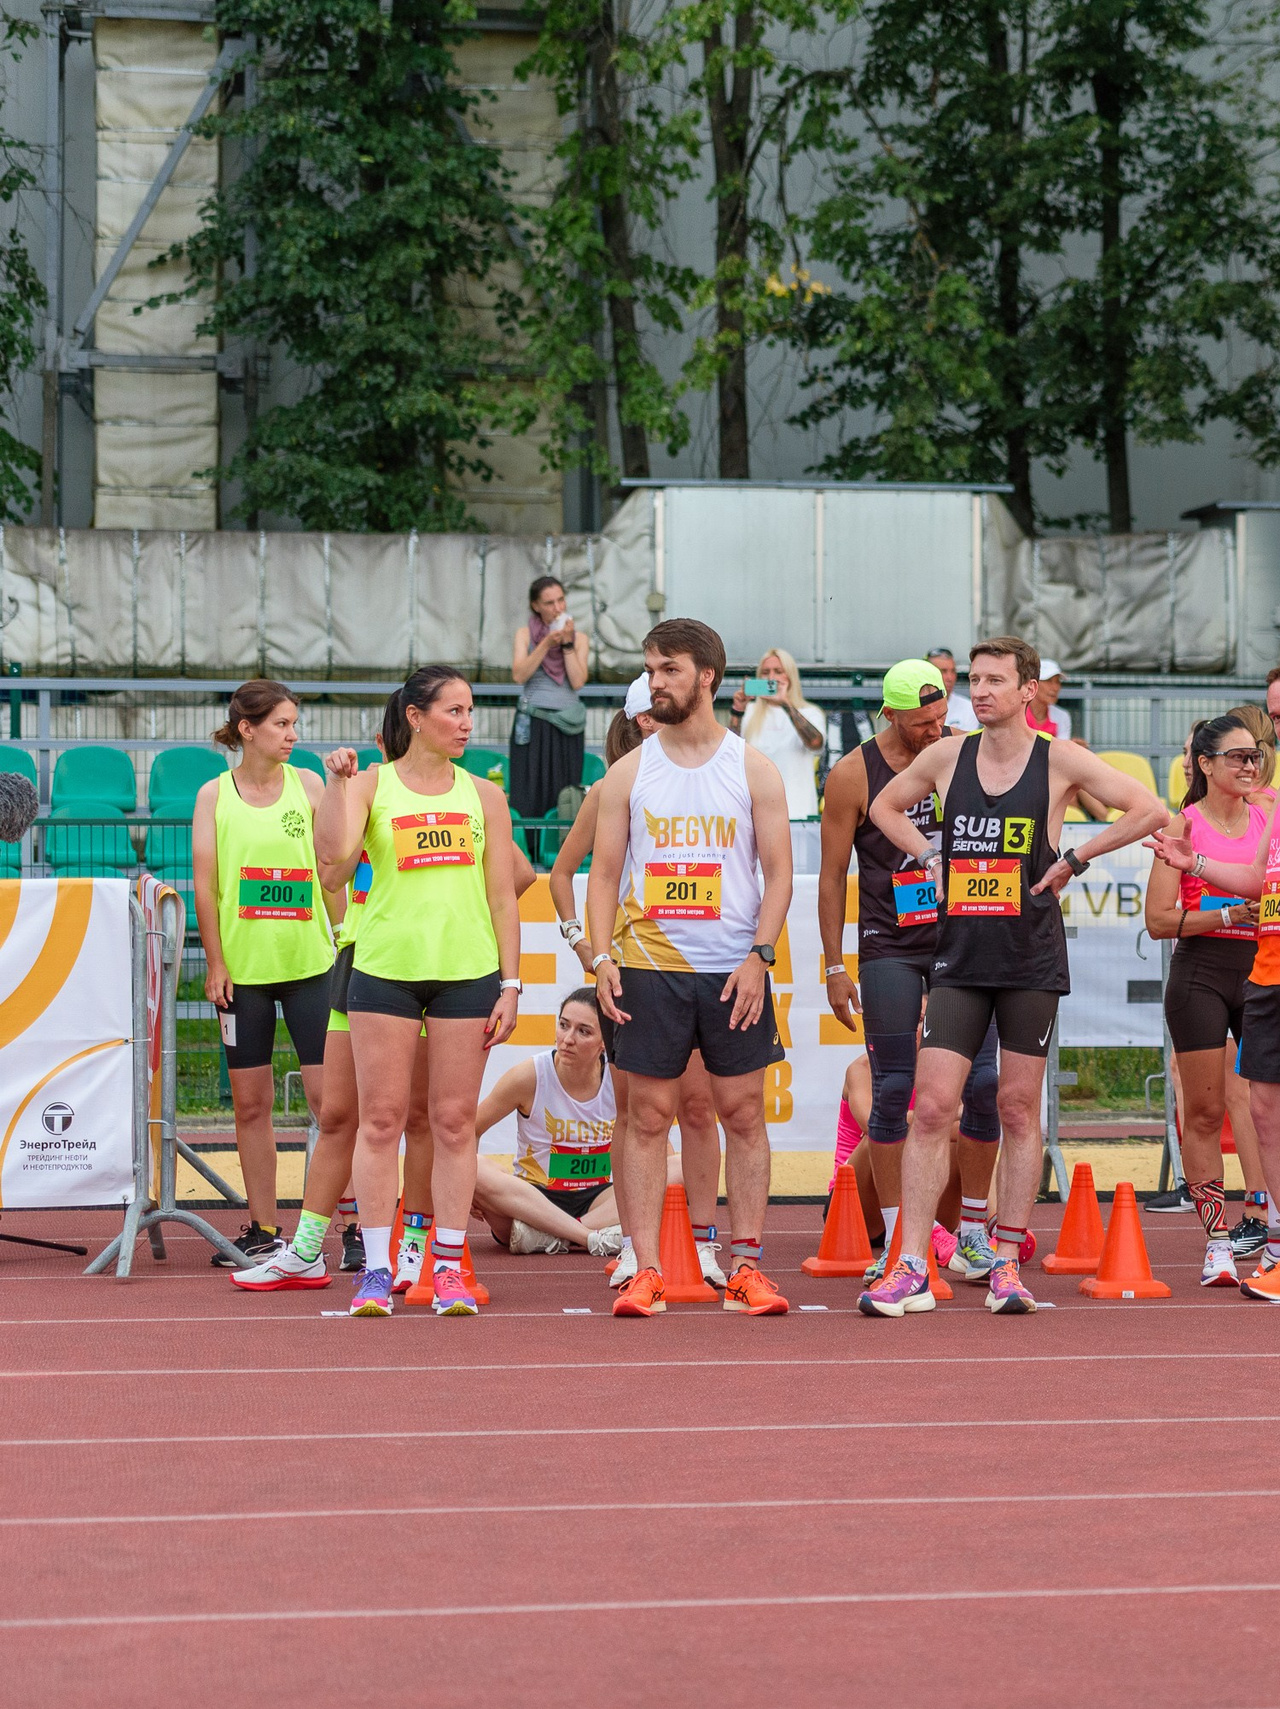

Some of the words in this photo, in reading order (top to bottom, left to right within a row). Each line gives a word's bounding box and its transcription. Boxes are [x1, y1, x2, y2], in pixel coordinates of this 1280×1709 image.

[416, 830, 452, 849] 200
[460, 838, 465, 847] 2
[655, 815, 736, 848] BEGYM
[953, 814, 1000, 838] SUB
[1007, 823, 1026, 848] 3
[952, 840, 998, 852] БЕГОМ!
[260, 885, 293, 903] 200
[299, 894, 305, 903] 4
[666, 882, 697, 900] 201
[706, 891, 713, 900] 2
[916, 886, 937, 906] 20
[967, 878, 999, 897] 202
[1006, 887, 1012, 897] 2
[1082, 882, 1142, 918] VB
[224, 1024, 228, 1035] 1
[20, 1139, 97, 1151] ЭнергоТрейд
[570, 1158, 596, 1175] 201
[602, 1164, 606, 1173] 4
